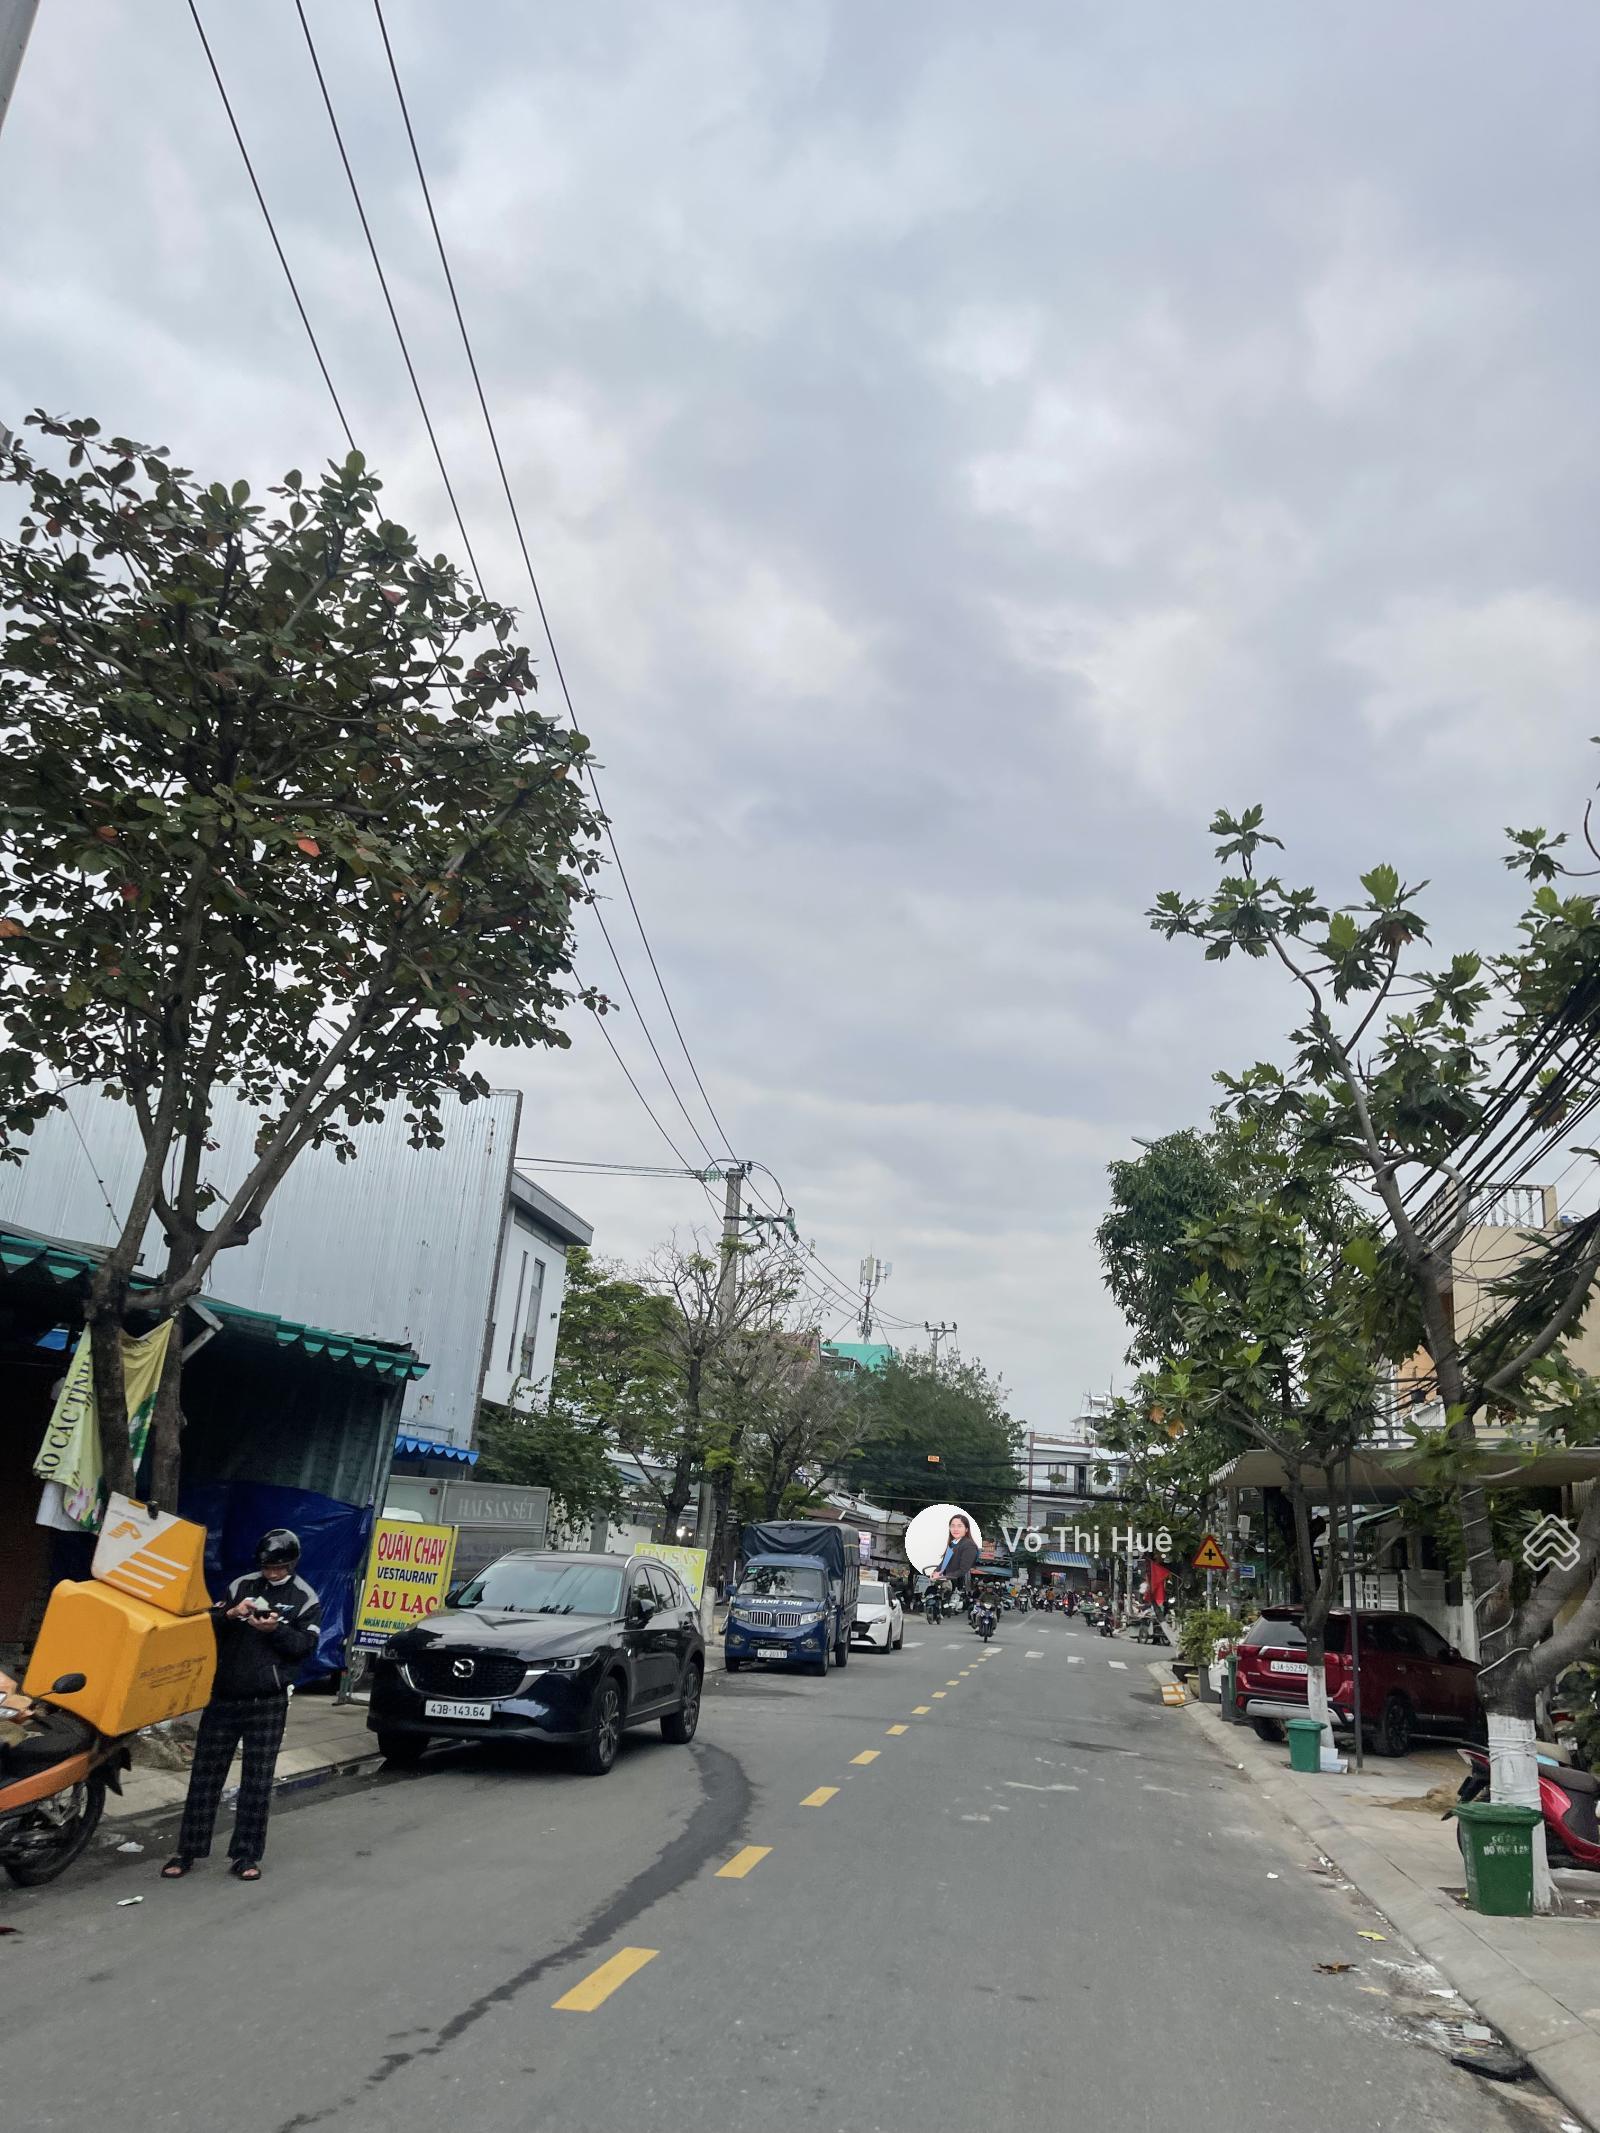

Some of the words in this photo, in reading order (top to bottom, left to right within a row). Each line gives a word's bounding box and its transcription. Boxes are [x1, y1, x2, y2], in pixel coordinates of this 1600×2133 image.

[51, 1409, 80, 1449] CÁC
[378, 1530, 412, 1562] QUÁN
[414, 1537, 447, 1566] CHAY
[377, 1566, 438, 1585] VESTAURANT
[367, 1584, 396, 1609] ÂU
[400, 1593, 438, 1618] LẠC
[431, 1704, 485, 1717] 43B-143.64
